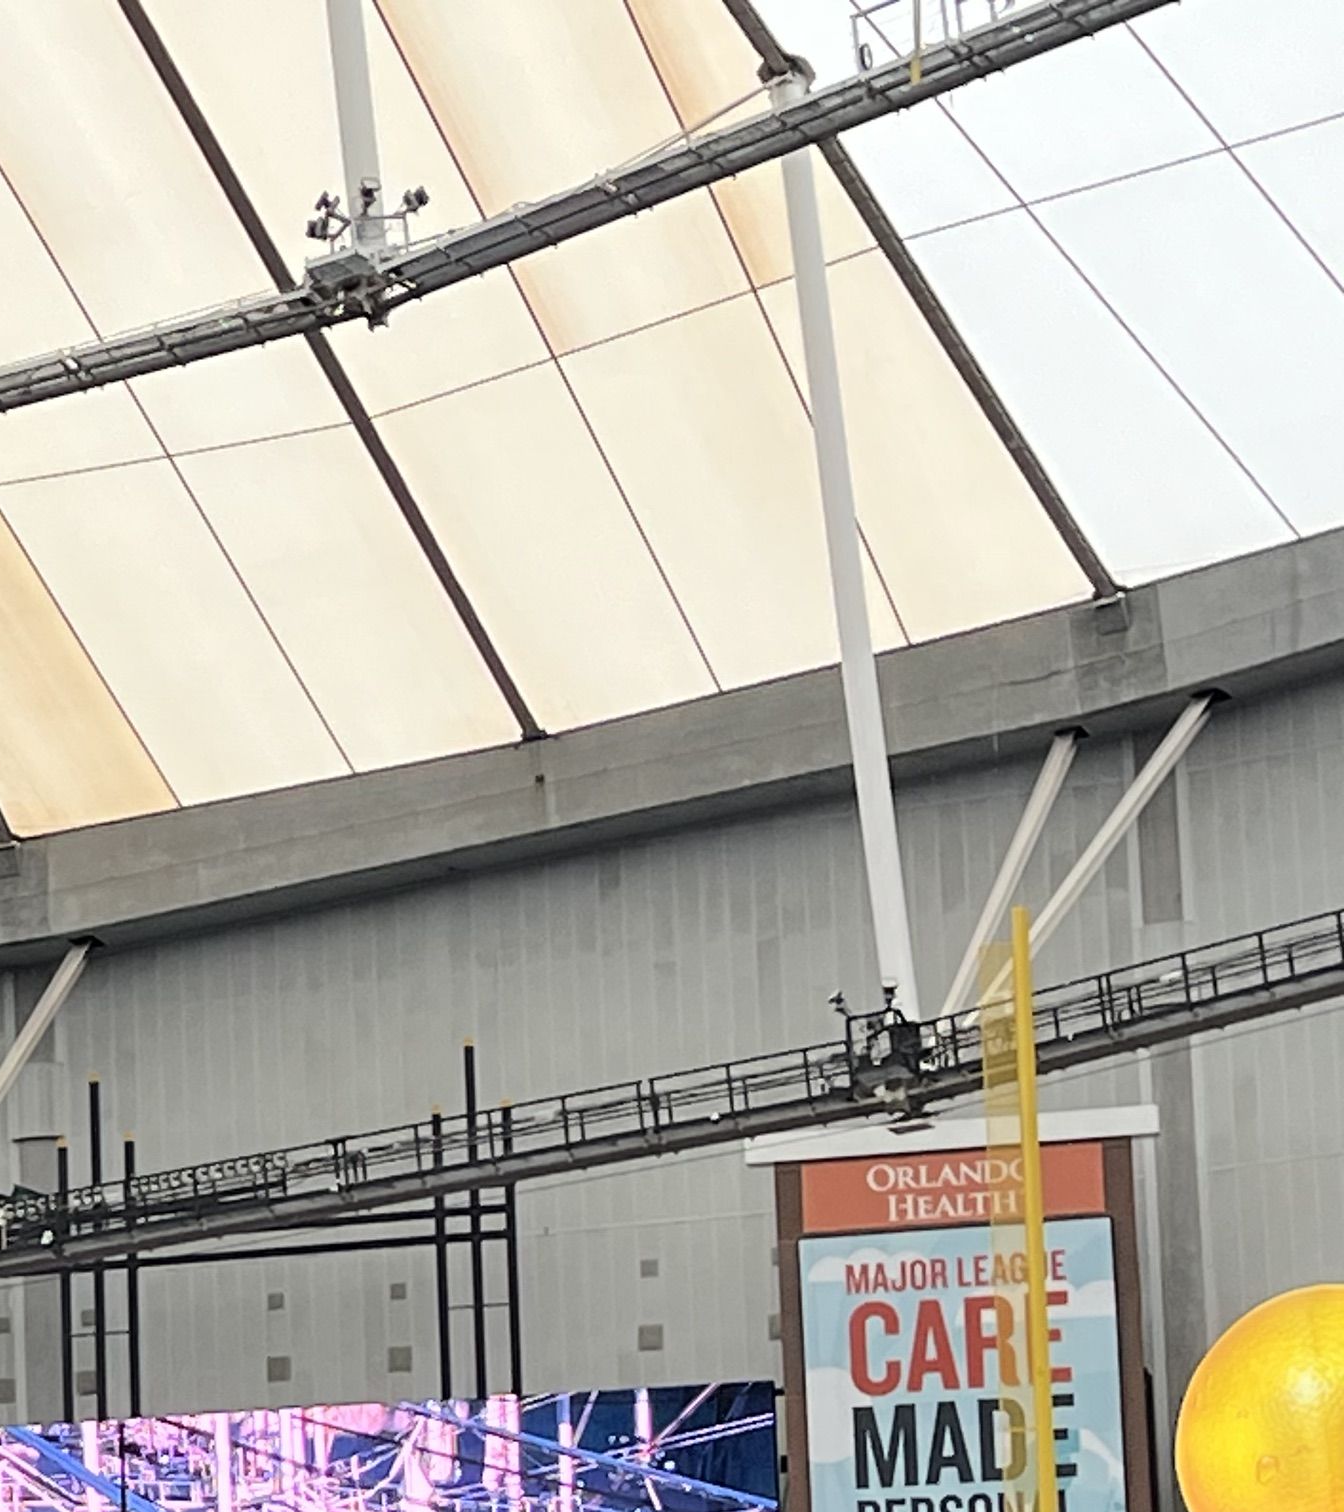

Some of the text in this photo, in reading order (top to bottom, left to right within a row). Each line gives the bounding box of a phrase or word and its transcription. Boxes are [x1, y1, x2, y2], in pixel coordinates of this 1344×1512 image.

[887, 1190, 1018, 1222] HEALTH
[845, 1249, 1068, 1295] MAJOR LEAGE
